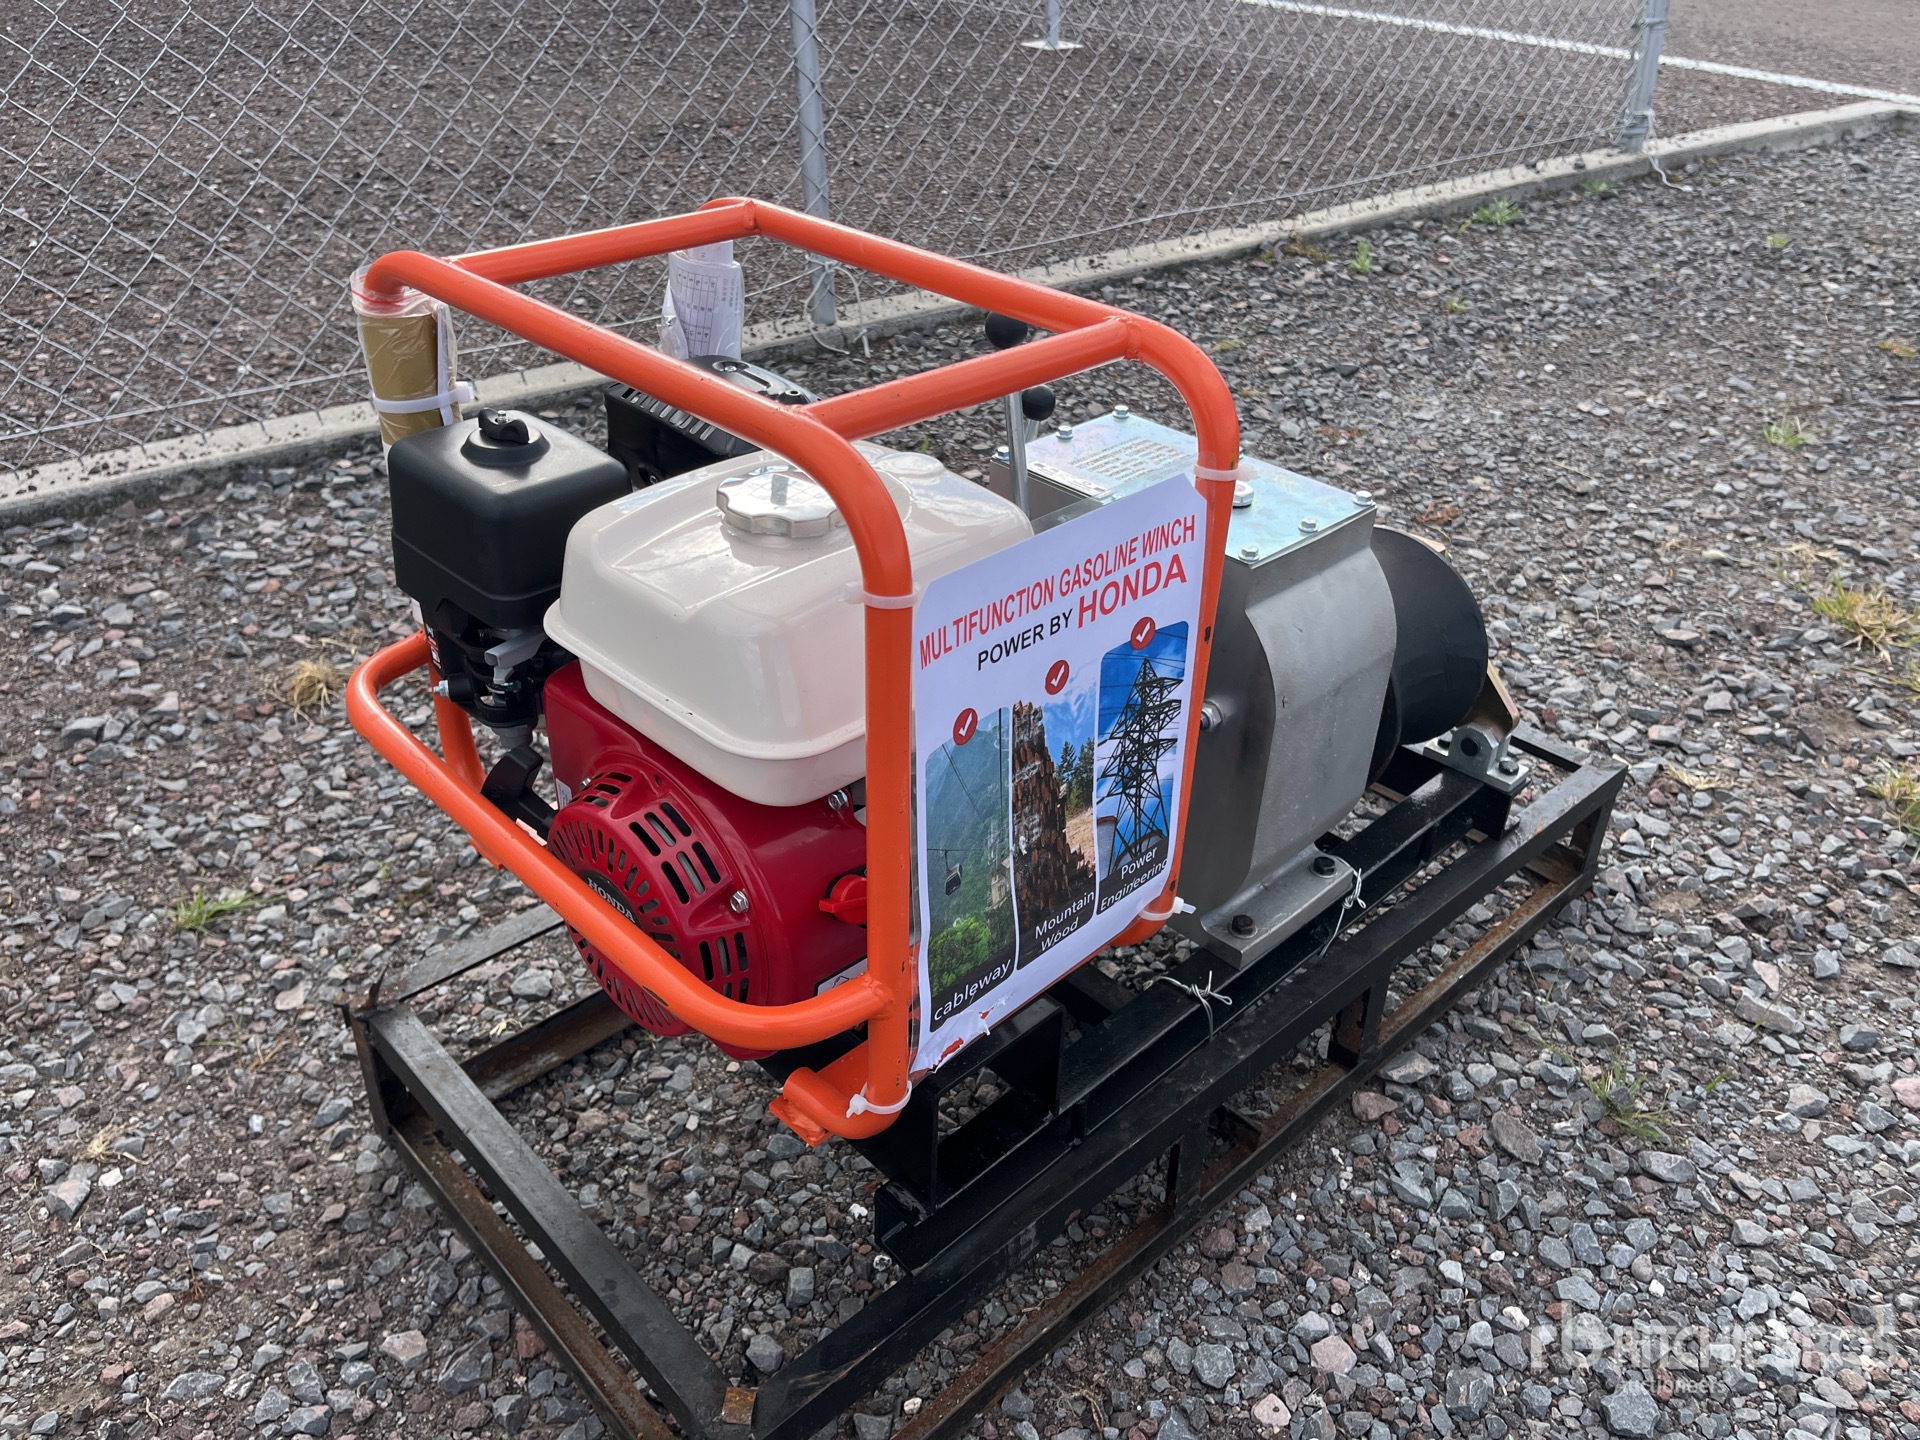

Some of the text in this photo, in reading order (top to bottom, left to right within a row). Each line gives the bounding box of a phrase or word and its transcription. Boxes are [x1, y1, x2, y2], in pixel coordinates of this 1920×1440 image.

[920, 514, 1196, 670] MULTIFUNCTION GASOLINE WINCH
[977, 553, 1187, 671] POWER BY HONDA
[1100, 858, 1169, 911] Engineering
[1121, 846, 1158, 880] Power
[587, 877, 636, 924] HONDA
[1035, 891, 1095, 940] Mountain
[1040, 917, 1079, 952] Wood
[933, 957, 1012, 1022] cableway
